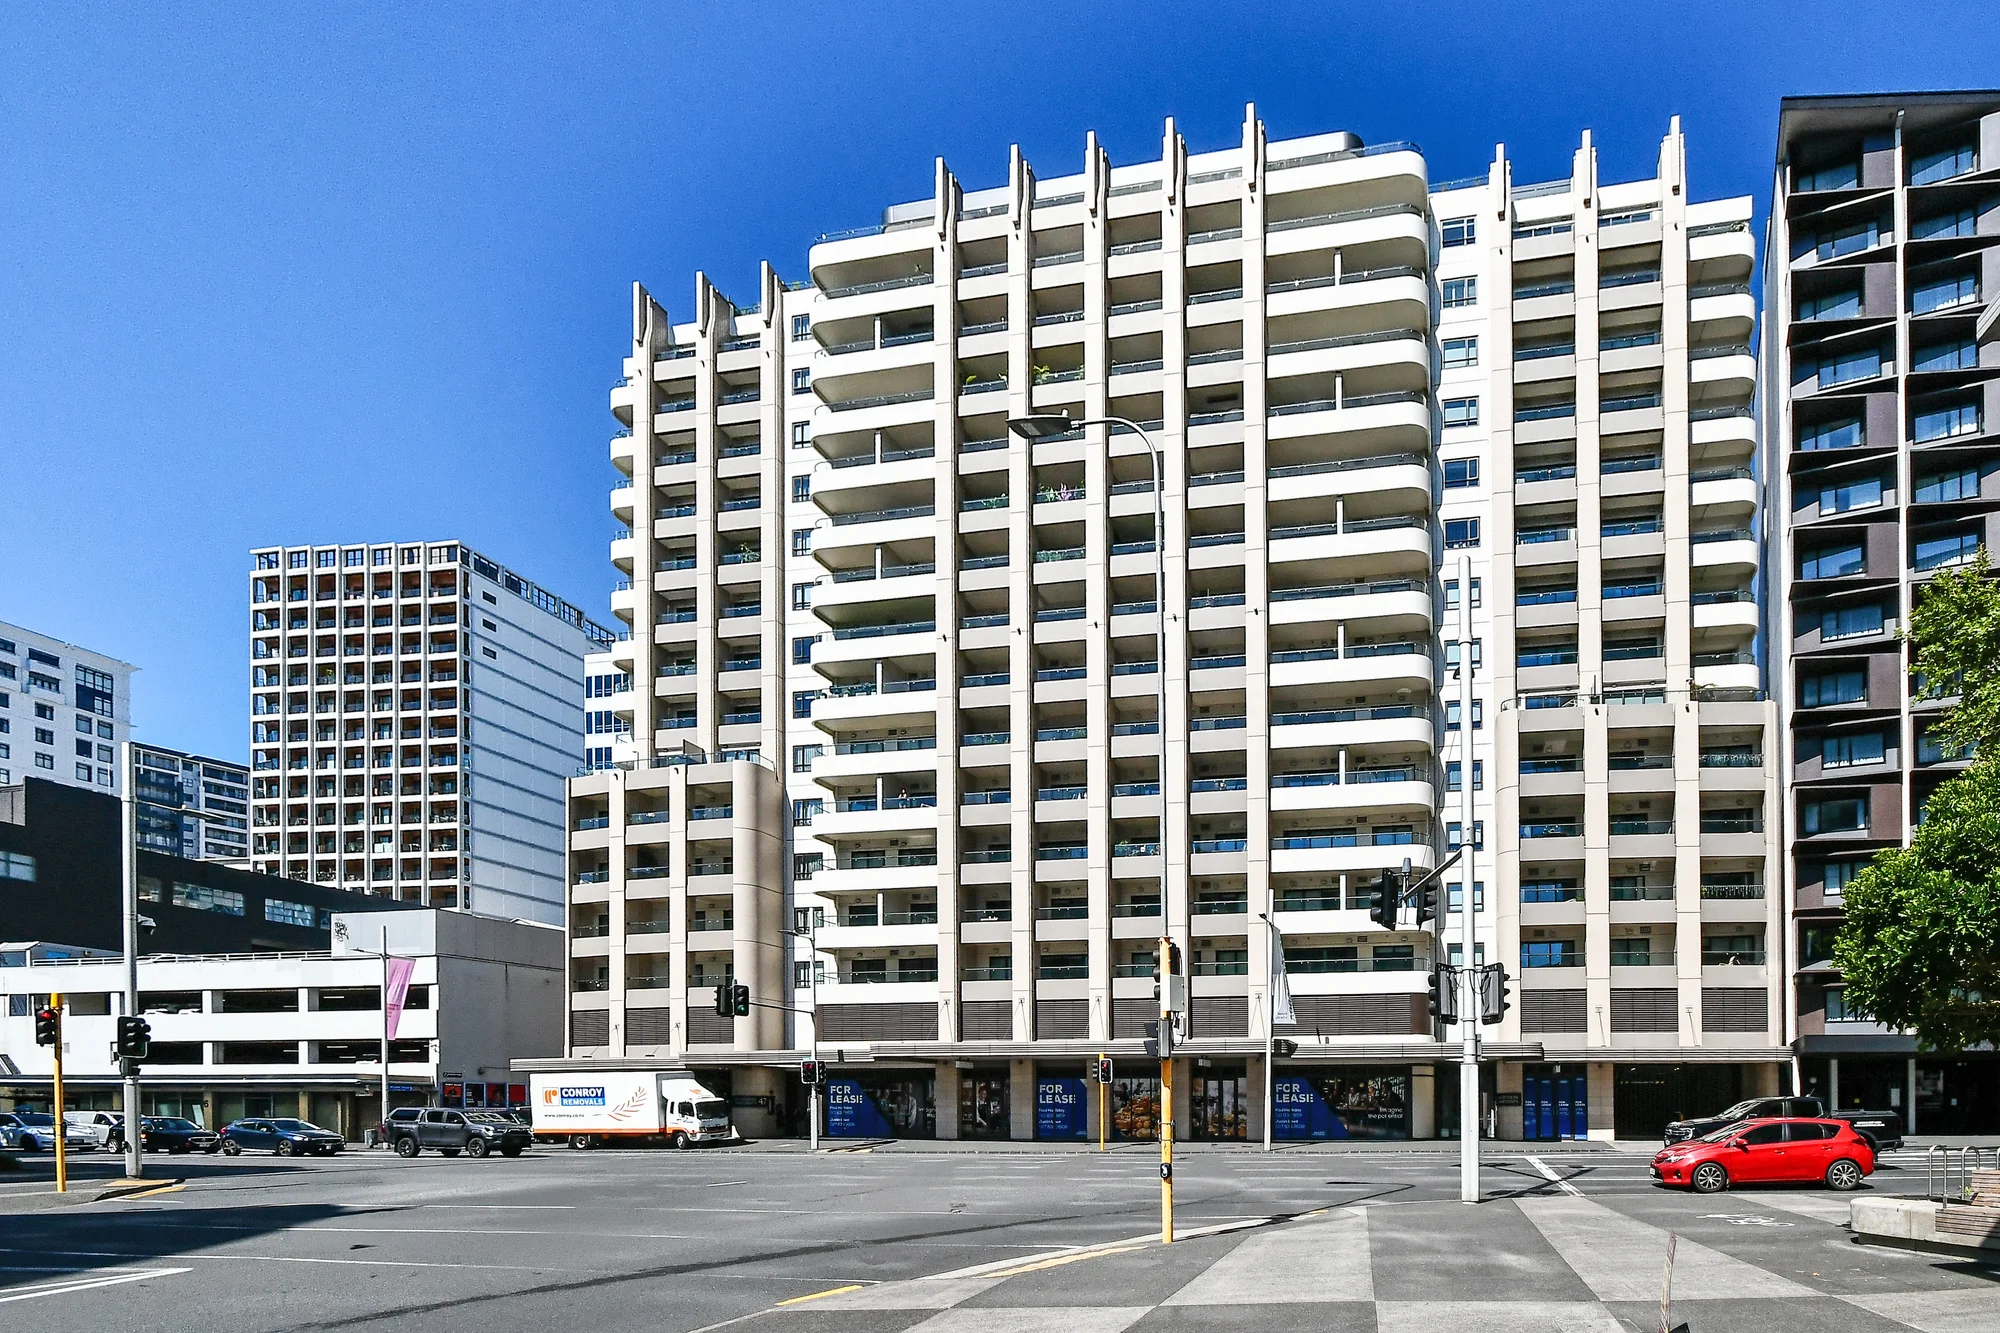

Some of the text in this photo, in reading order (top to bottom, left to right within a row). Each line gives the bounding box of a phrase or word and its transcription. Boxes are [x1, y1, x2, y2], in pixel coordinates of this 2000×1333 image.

[561, 1088, 602, 1097] CONROY
[830, 1085, 851, 1094] FOR
[1039, 1084, 1063, 1094] FOR
[1275, 1083, 1300, 1093] FOR
[830, 1095, 863, 1104] LEASE
[1039, 1094, 1076, 1104] LEASE
[1275, 1094, 1314, 1103] LEASE
